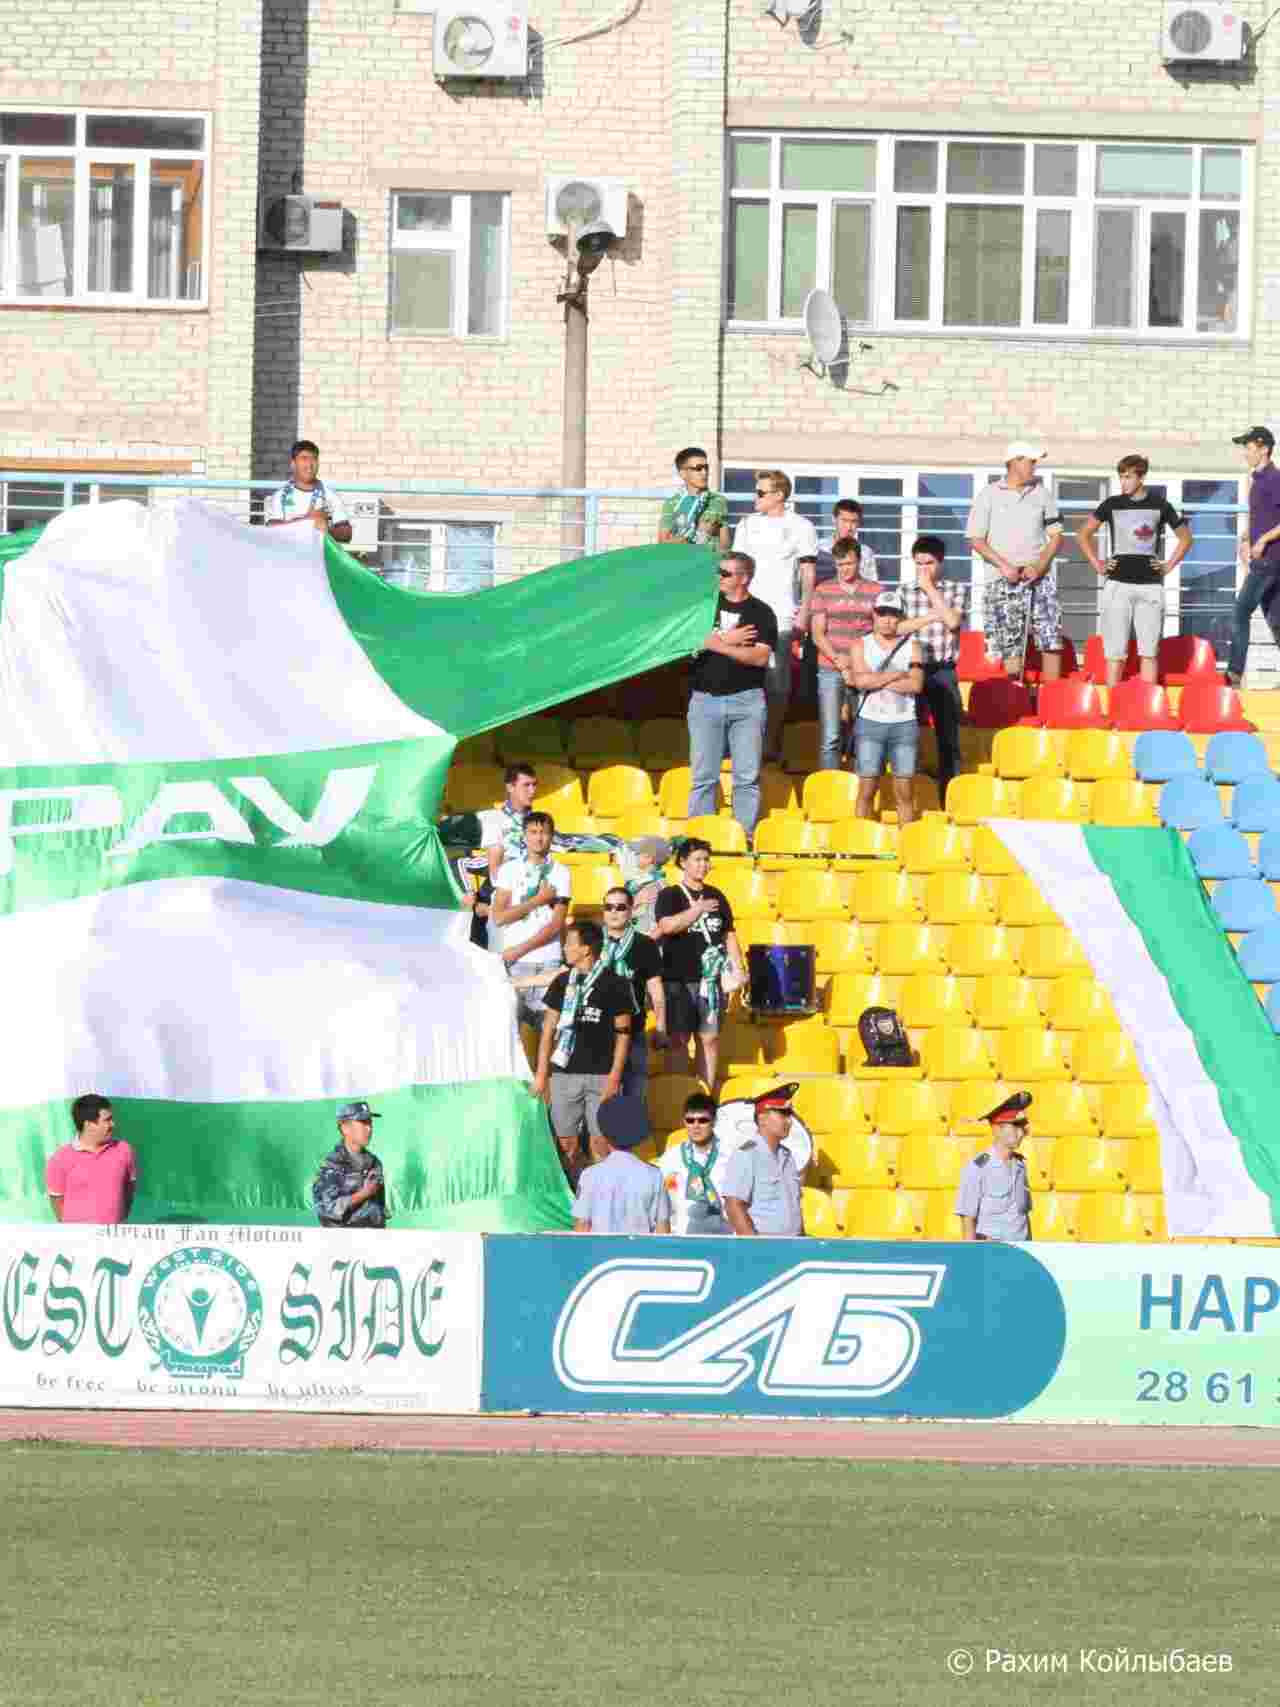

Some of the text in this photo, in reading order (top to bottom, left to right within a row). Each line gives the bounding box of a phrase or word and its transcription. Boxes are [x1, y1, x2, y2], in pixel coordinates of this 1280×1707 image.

[279, 1258, 447, 1366] SIDE
[552, 1258, 947, 1398] СЛБ
[1136, 1371, 1252, 1403] 28 61
